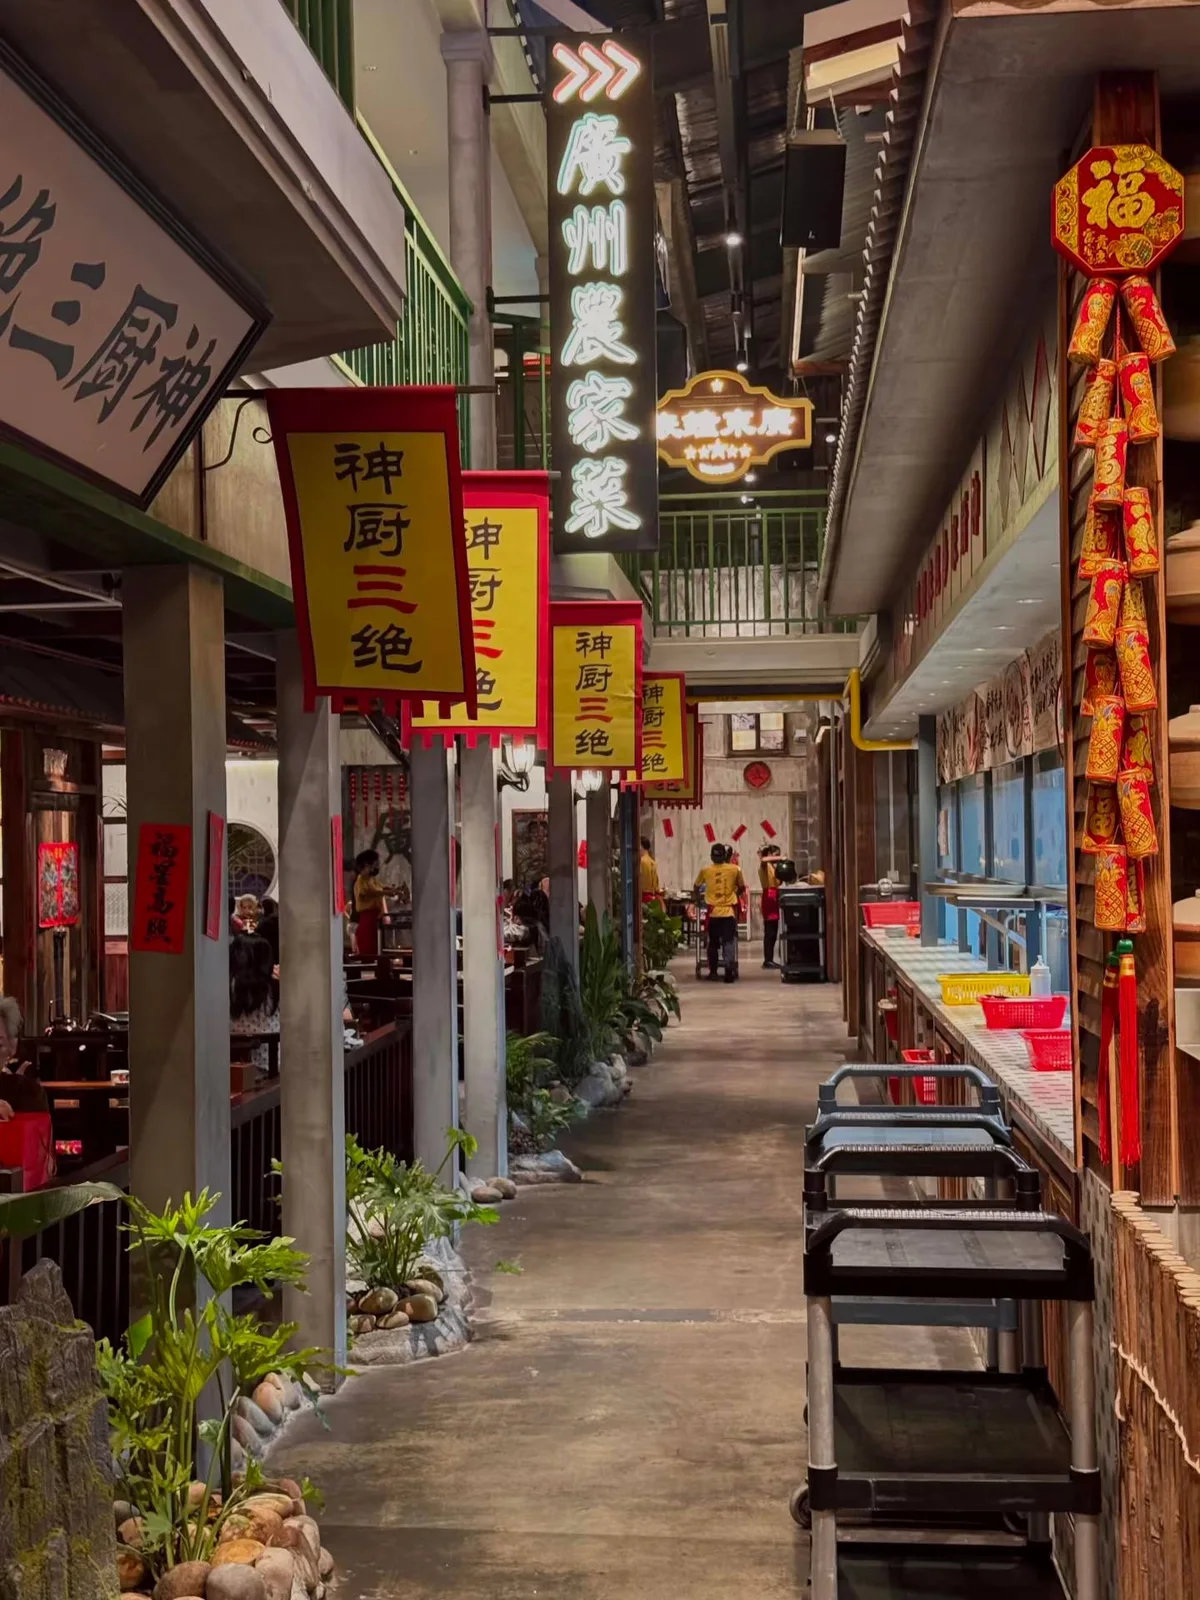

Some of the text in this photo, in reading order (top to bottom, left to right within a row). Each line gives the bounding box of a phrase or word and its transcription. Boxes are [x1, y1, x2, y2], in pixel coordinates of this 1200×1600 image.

[1081, 157, 1156, 229] 福
[556, 112, 642, 539] 廣州農家菜
[333, 441, 423, 675] 神厨三绝
[574, 630, 614, 757] 神厨三绝
[641, 683, 669, 773] 神厨三绝
